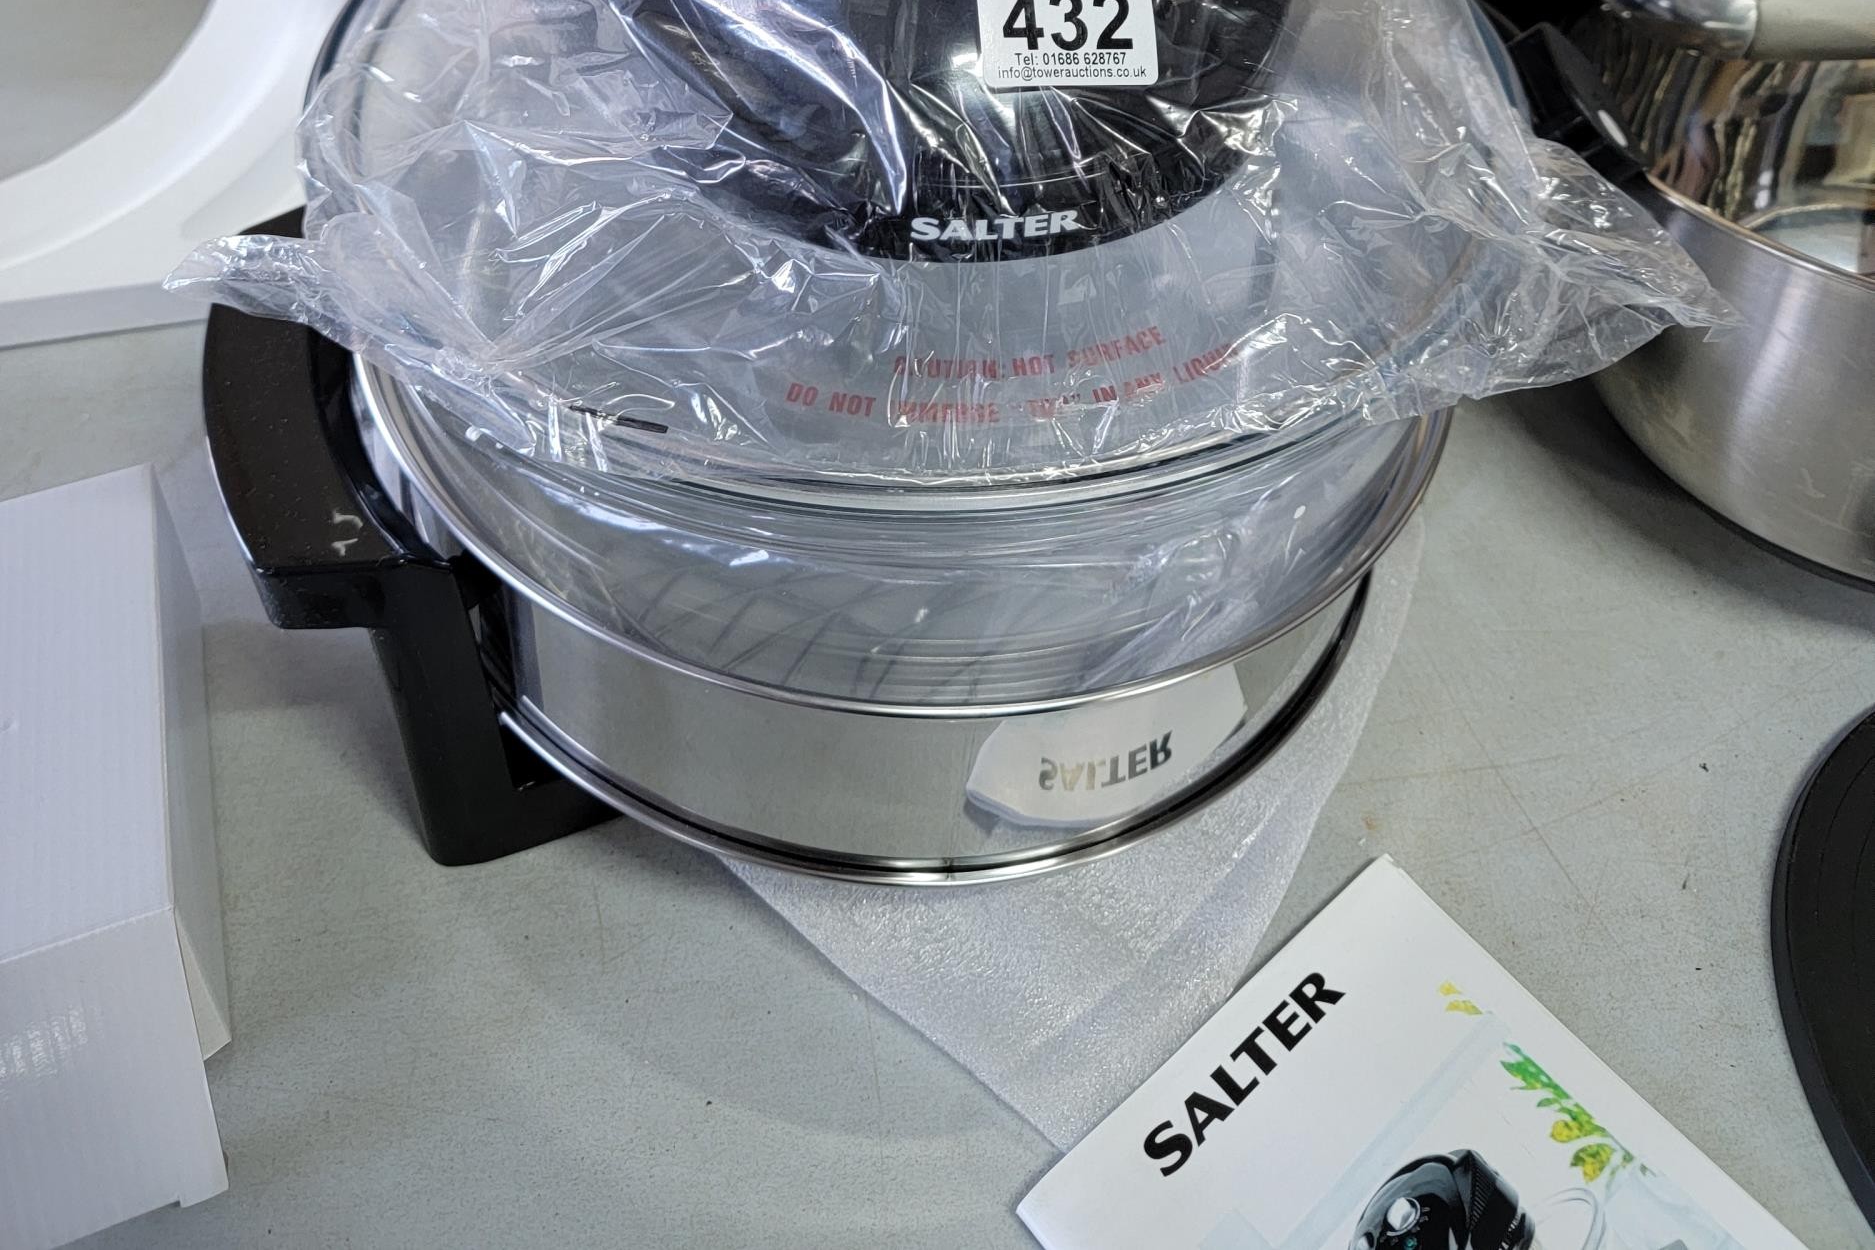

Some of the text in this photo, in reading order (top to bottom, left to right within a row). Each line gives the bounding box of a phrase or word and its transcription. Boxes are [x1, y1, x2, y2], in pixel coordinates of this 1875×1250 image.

[998, 66, 1147, 81] info@towerauctions.co.uk
[1015, 52, 1127, 66] Tel: 01686 628767
[910, 210, 1080, 241] SALTER
[1012, 354, 1055, 377] HOT
[1067, 326, 1166, 368] SURFACE
[786, 382, 819, 407] DO
[828, 391, 877, 418] NOT
[1092, 385, 1119, 404] IN
[1143, 971, 1345, 1177] SALTER
